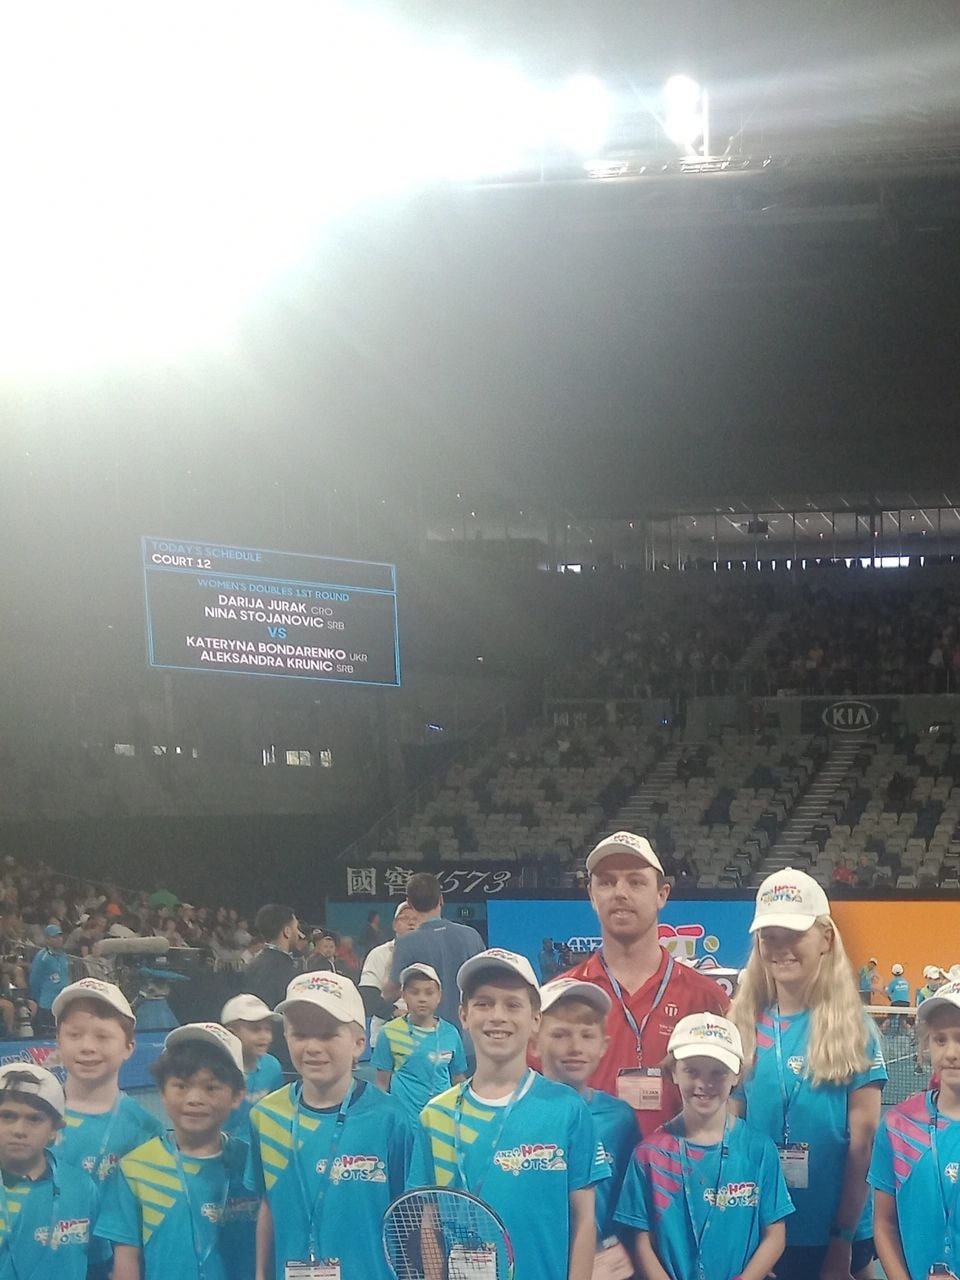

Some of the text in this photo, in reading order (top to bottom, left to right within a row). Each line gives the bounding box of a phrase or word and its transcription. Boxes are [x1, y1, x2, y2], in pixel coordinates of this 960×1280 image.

[152, 541, 262, 562] TODAY'S SCHEDULE
[152, 553, 212, 569] COURT 12
[197, 579, 350, 602] WOMEN'S DOUBLES 1ST ROUND
[218, 594, 333, 616] DARIJA JURAK CRO
[204, 606, 345, 630] NINA STOJANOVIC SRB
[267, 626, 288, 639] VS
[186, 636, 368, 662] KATERYNA BONDARENKO UKR
[200, 650, 354, 673] ALEKSANDRA KRUNIC SRB
[833, 708, 869, 725] KIA
